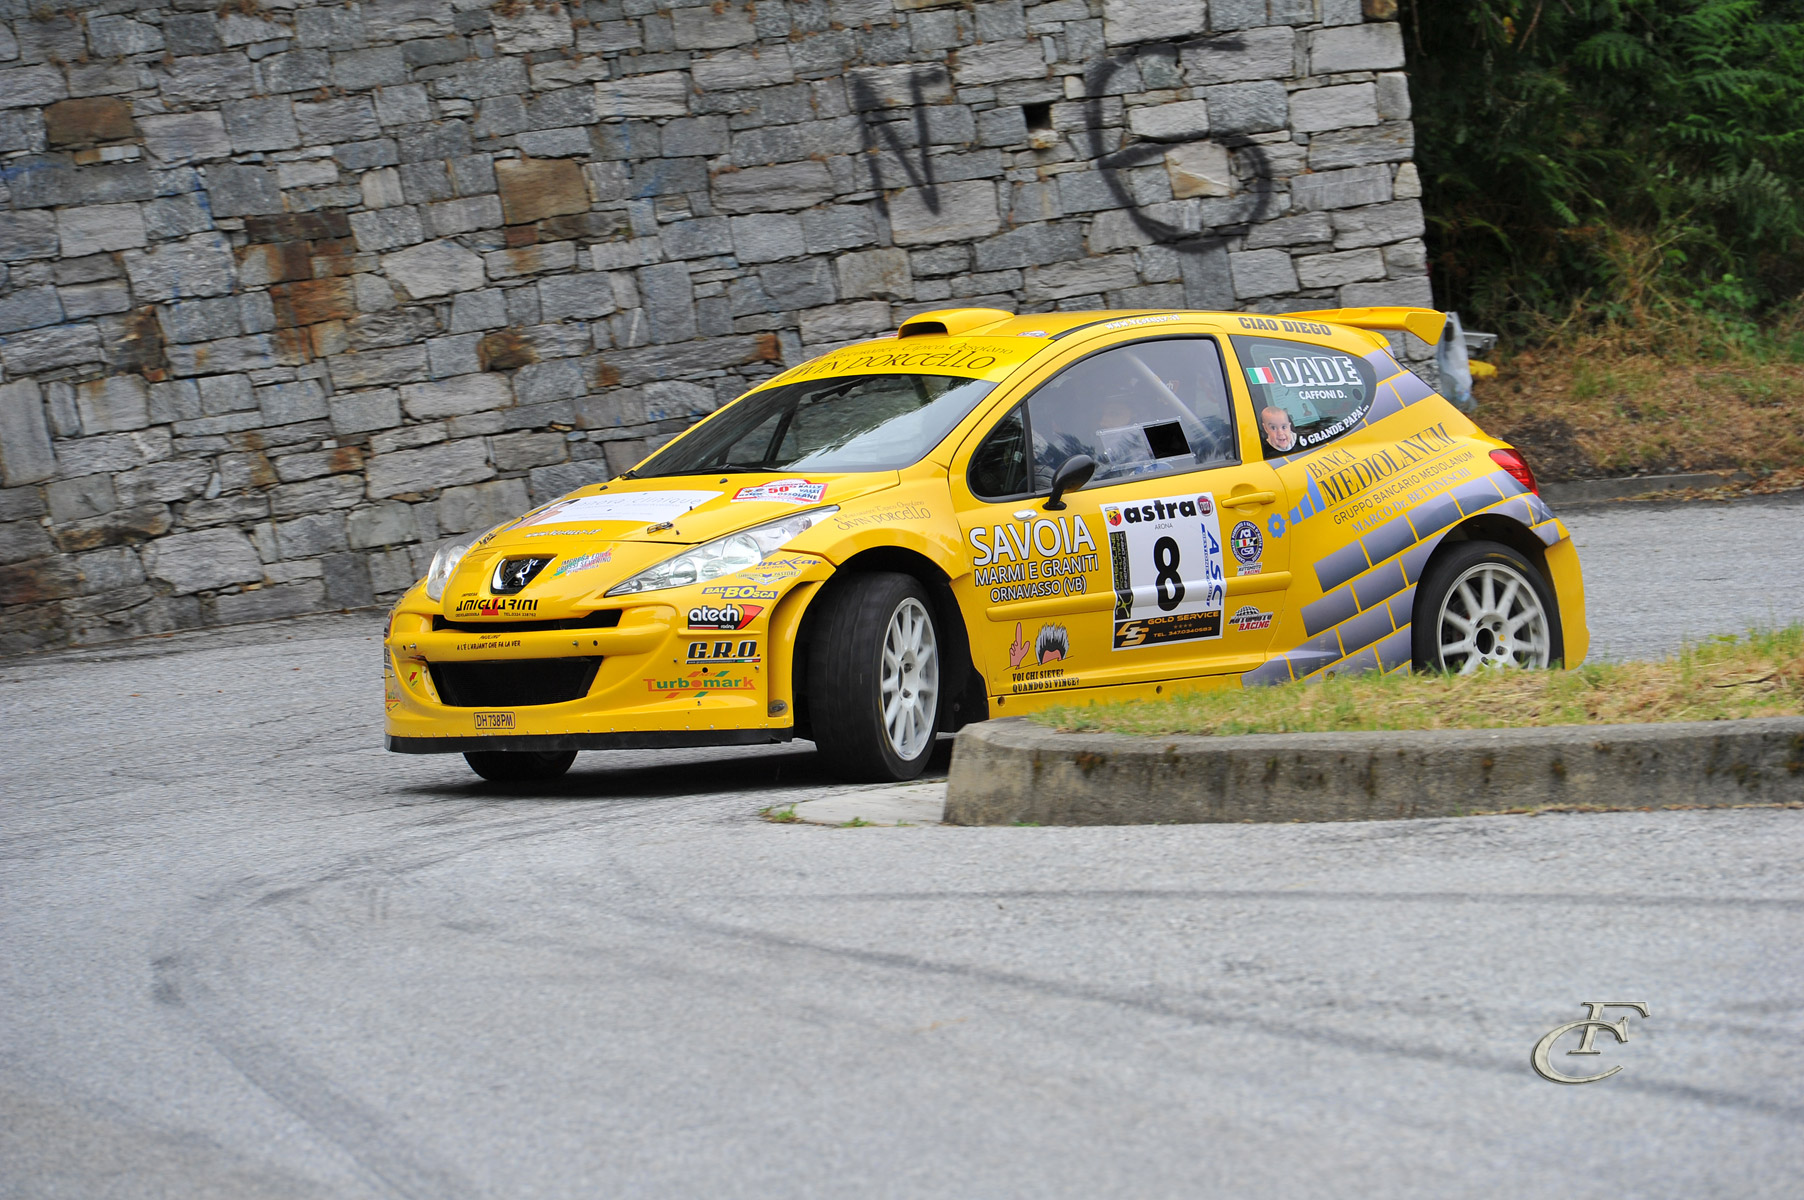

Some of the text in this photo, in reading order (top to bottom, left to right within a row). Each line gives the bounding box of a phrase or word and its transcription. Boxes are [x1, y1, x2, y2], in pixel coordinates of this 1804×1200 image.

[1238, 317, 1332, 335] CIAO DIEGO
[1269, 356, 1363, 388] DADE
[1298, 389, 1347, 400] CAFFONI D.
[1307, 423, 1345, 444] GRANDE
[1306, 447, 1356, 479] BANCA
[1318, 422, 1458, 508] MEDIOLANUM
[1333, 450, 1475, 525] GRUPPO BANCARIO MEDIOLANUM
[1123, 499, 1197, 524] astra
[1351, 467, 1473, 535] MARCO Dr. BETTINESCHI
[1154, 522, 1173, 531] ARONA
[968, 514, 1097, 566] SAVOIA
[974, 553, 1099, 587] MARMI E GRANITI
[1153, 535, 1186, 612] 8
[1207, 529, 1224, 607] ASC
[990, 574, 1087, 603] ORNAVASSO (VB)
[689, 604, 739, 622] atech
[1147, 611, 1219, 626] GOLD SERVICE
[1238, 620, 1270, 632] RACING
[687, 640, 761, 659] G.R.O.
[1012, 669, 1064, 682] VOI CHI SIETE?
[1012, 677, 1080, 693] QUANDO SI VINCE?
